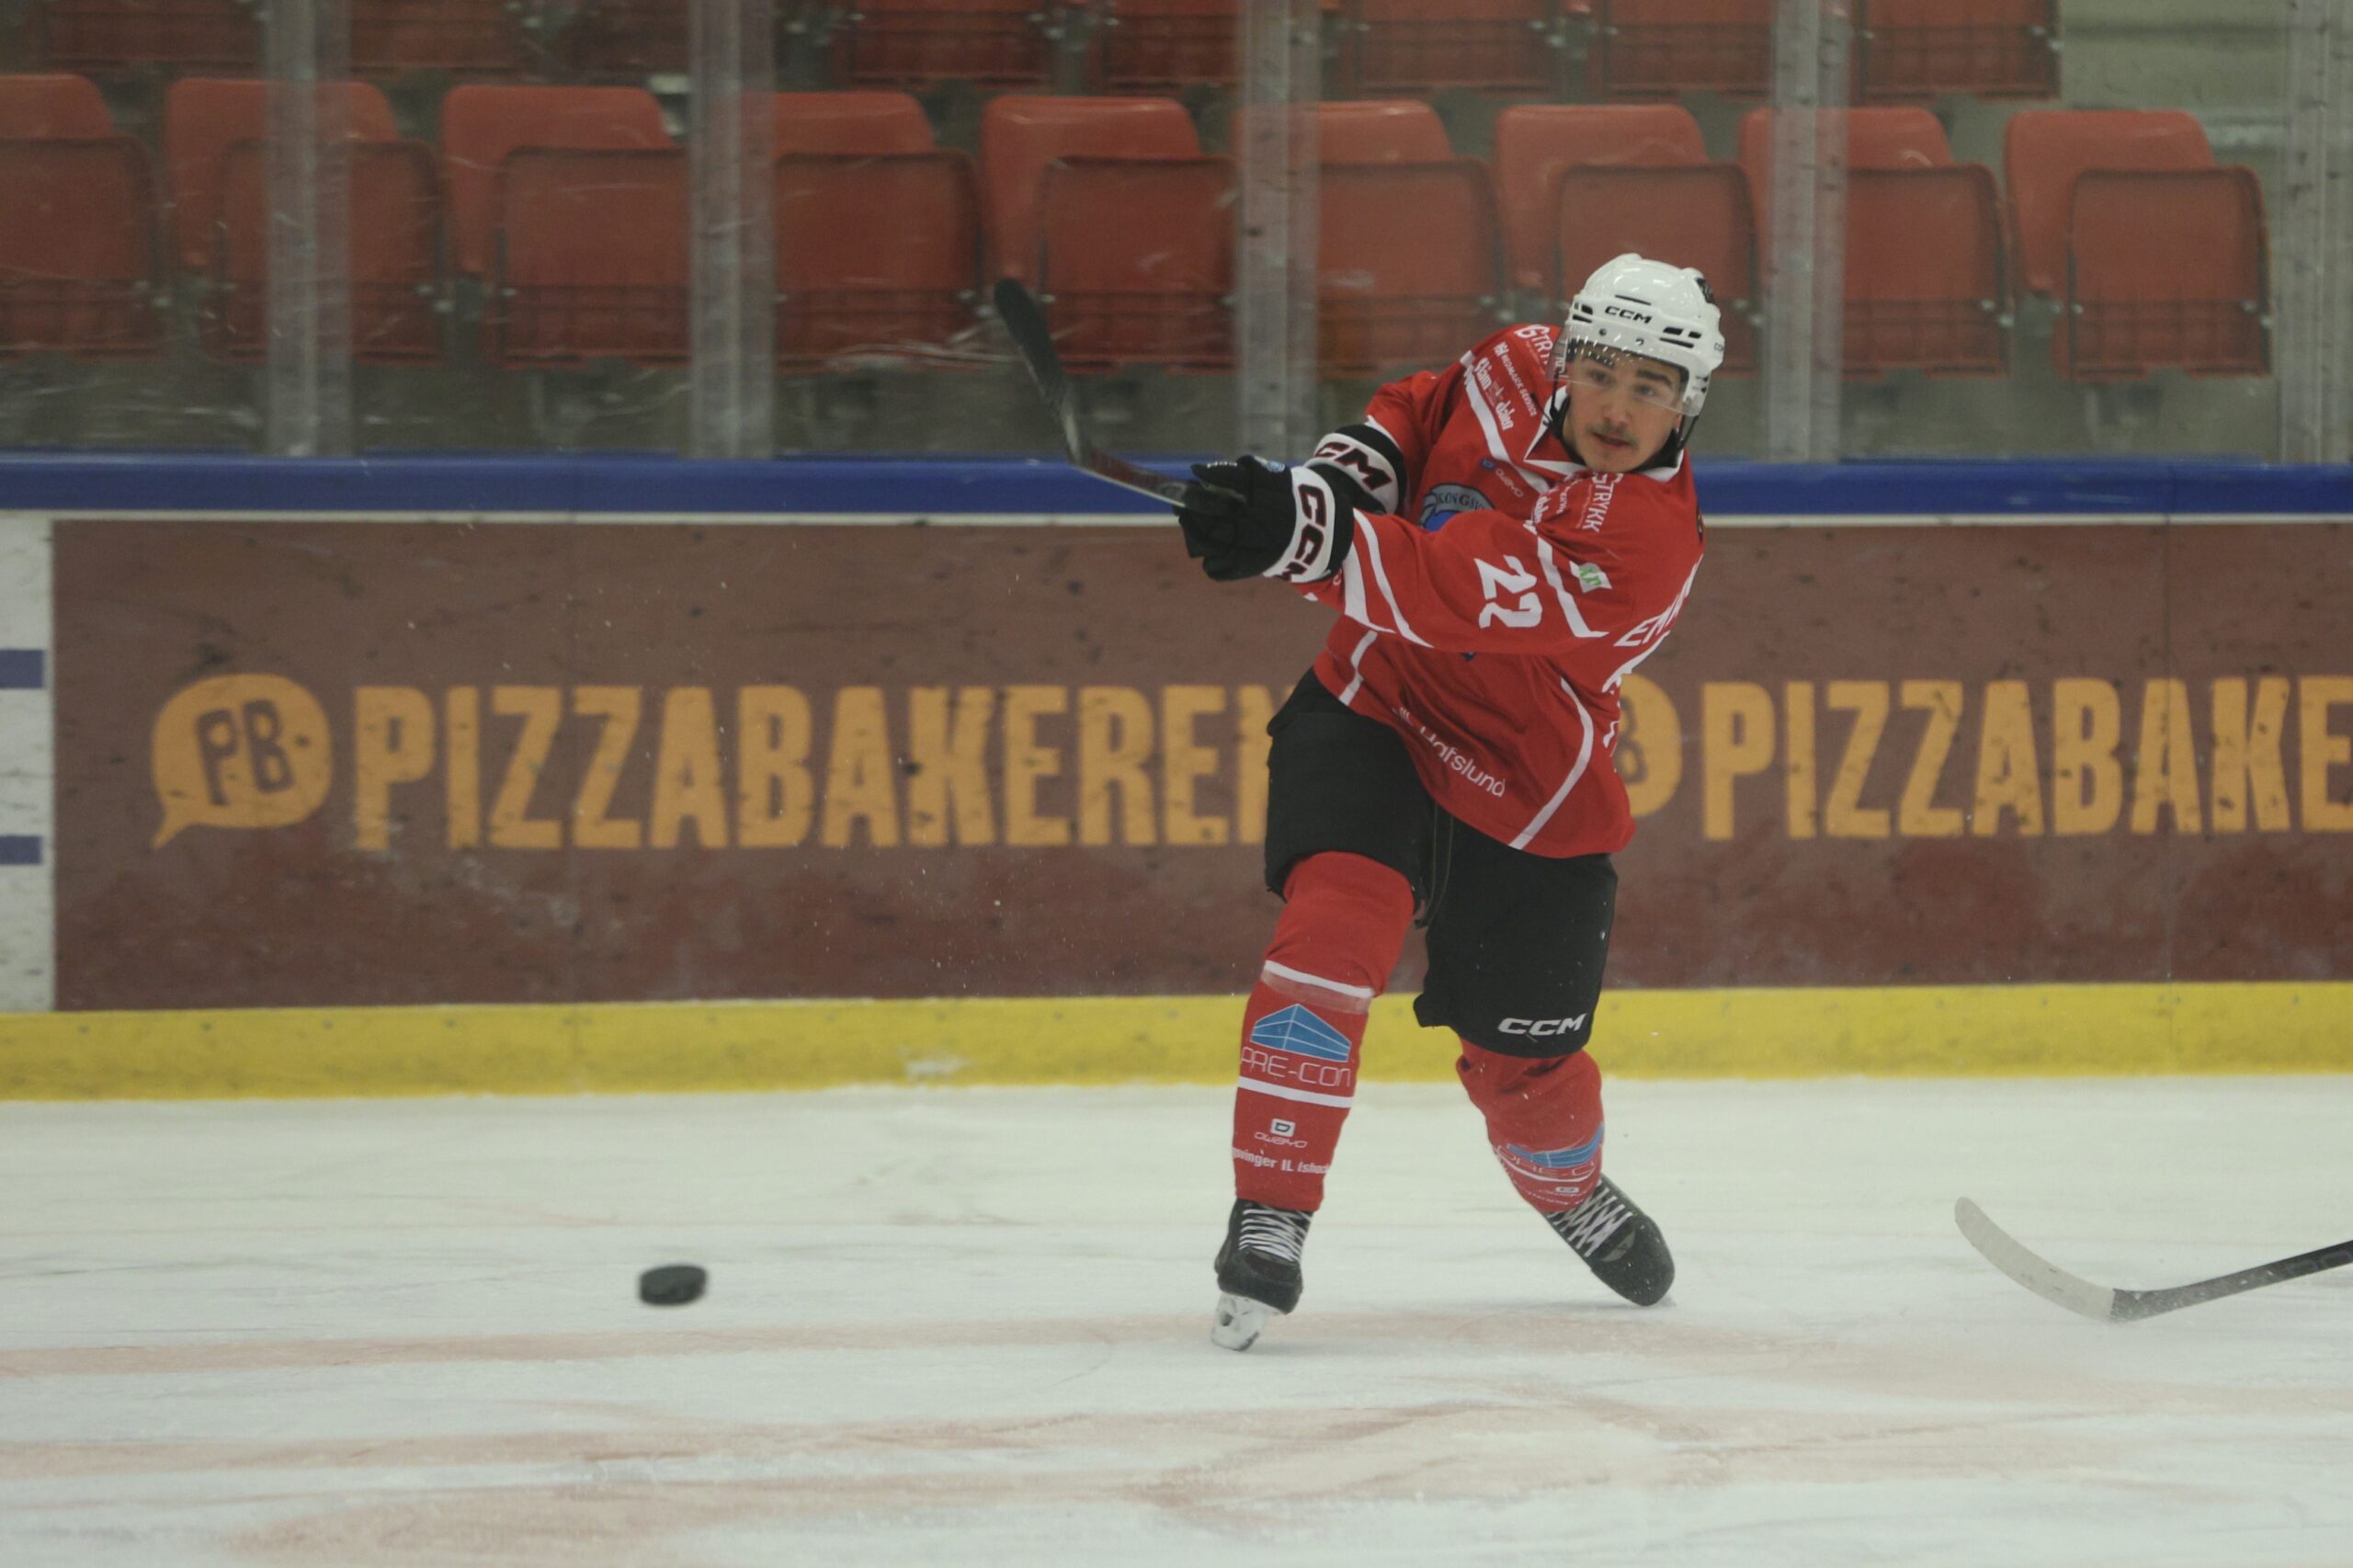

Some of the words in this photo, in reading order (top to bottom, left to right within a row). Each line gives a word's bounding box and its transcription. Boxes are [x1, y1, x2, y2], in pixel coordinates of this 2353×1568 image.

[1605, 306, 1653, 324] CCM
[1314, 441, 1393, 491] CM
[1473, 554, 1543, 629] 22
[195, 699, 296, 807] PB
[1497, 1012, 1588, 1037] CCM
